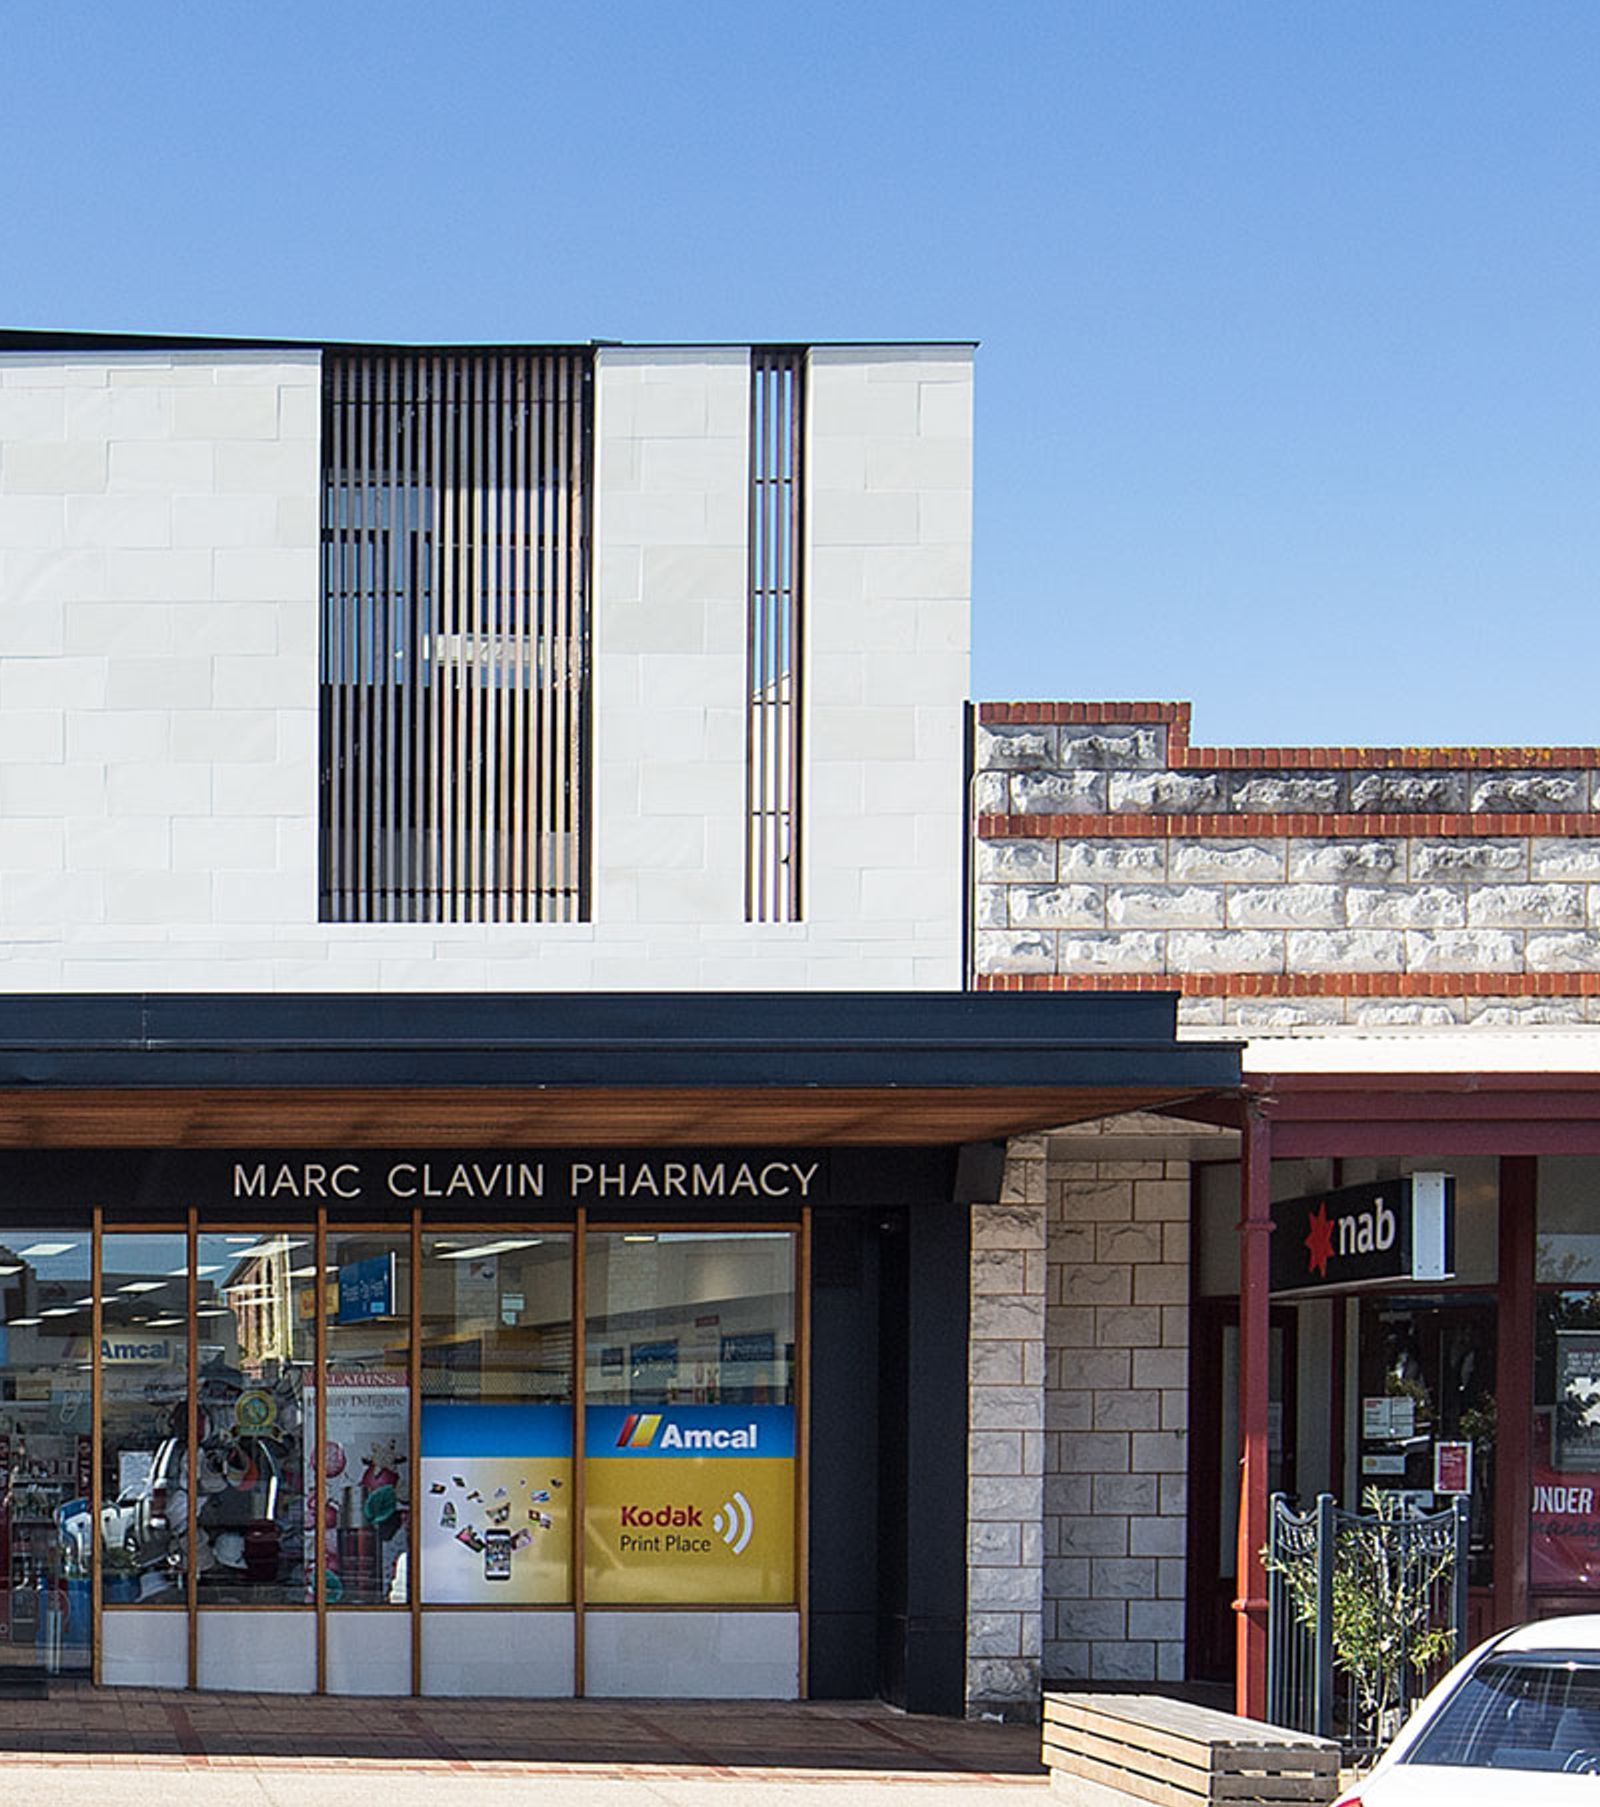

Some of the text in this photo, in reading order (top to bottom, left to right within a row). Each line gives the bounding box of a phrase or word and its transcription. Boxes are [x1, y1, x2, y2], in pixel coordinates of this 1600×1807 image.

[233, 1163, 819, 1198] MARC CLAVIN PHARMACY
[1337, 1197, 1395, 1256] nab
[101, 1339, 169, 1359] Amcal
[660, 1424, 757, 1450] Amcal
[620, 1505, 703, 1528] Kodak
[620, 1535, 711, 1553] Print Place
